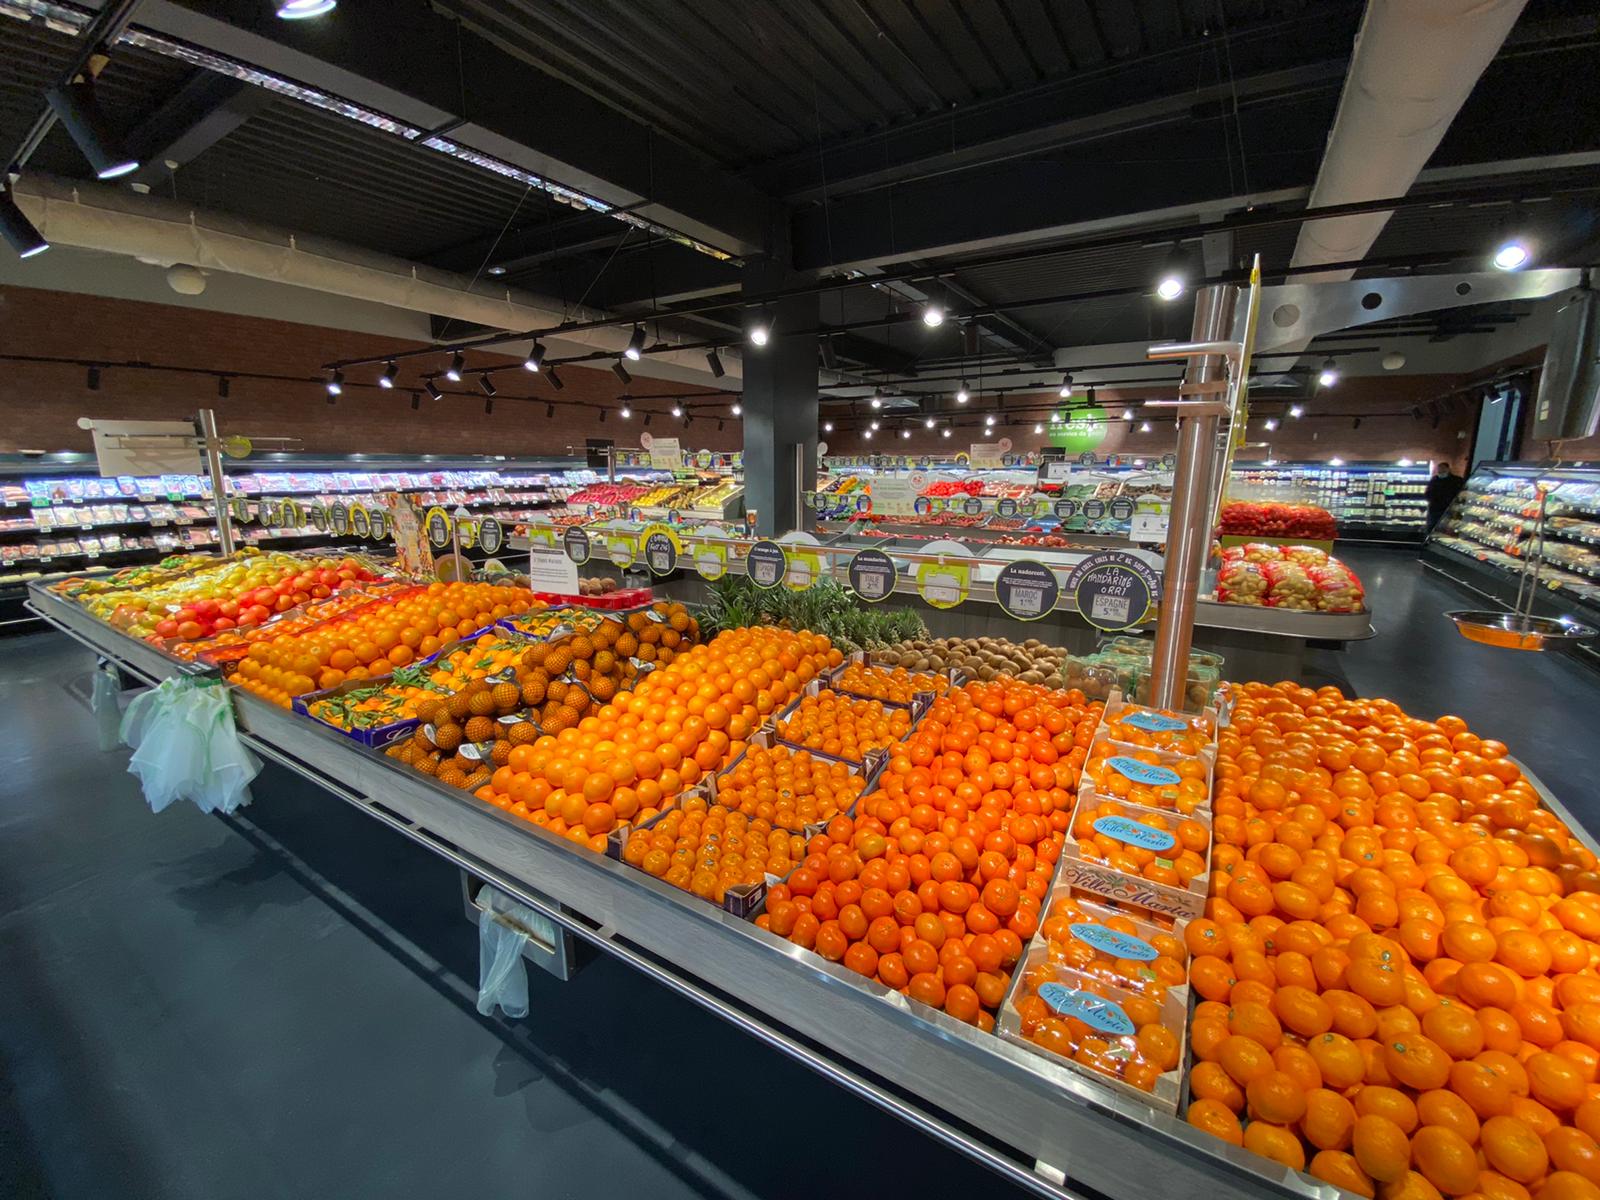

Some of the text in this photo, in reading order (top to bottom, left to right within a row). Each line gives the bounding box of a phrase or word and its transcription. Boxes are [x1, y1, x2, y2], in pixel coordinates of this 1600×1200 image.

[1106, 567, 1119, 575] LA
[1015, 588, 1038, 600] MAROC
[1096, 597, 1128, 610] ESPAGNE
[1126, 828, 1168, 847] Maria
[1066, 865, 1194, 920] Villa Maria
